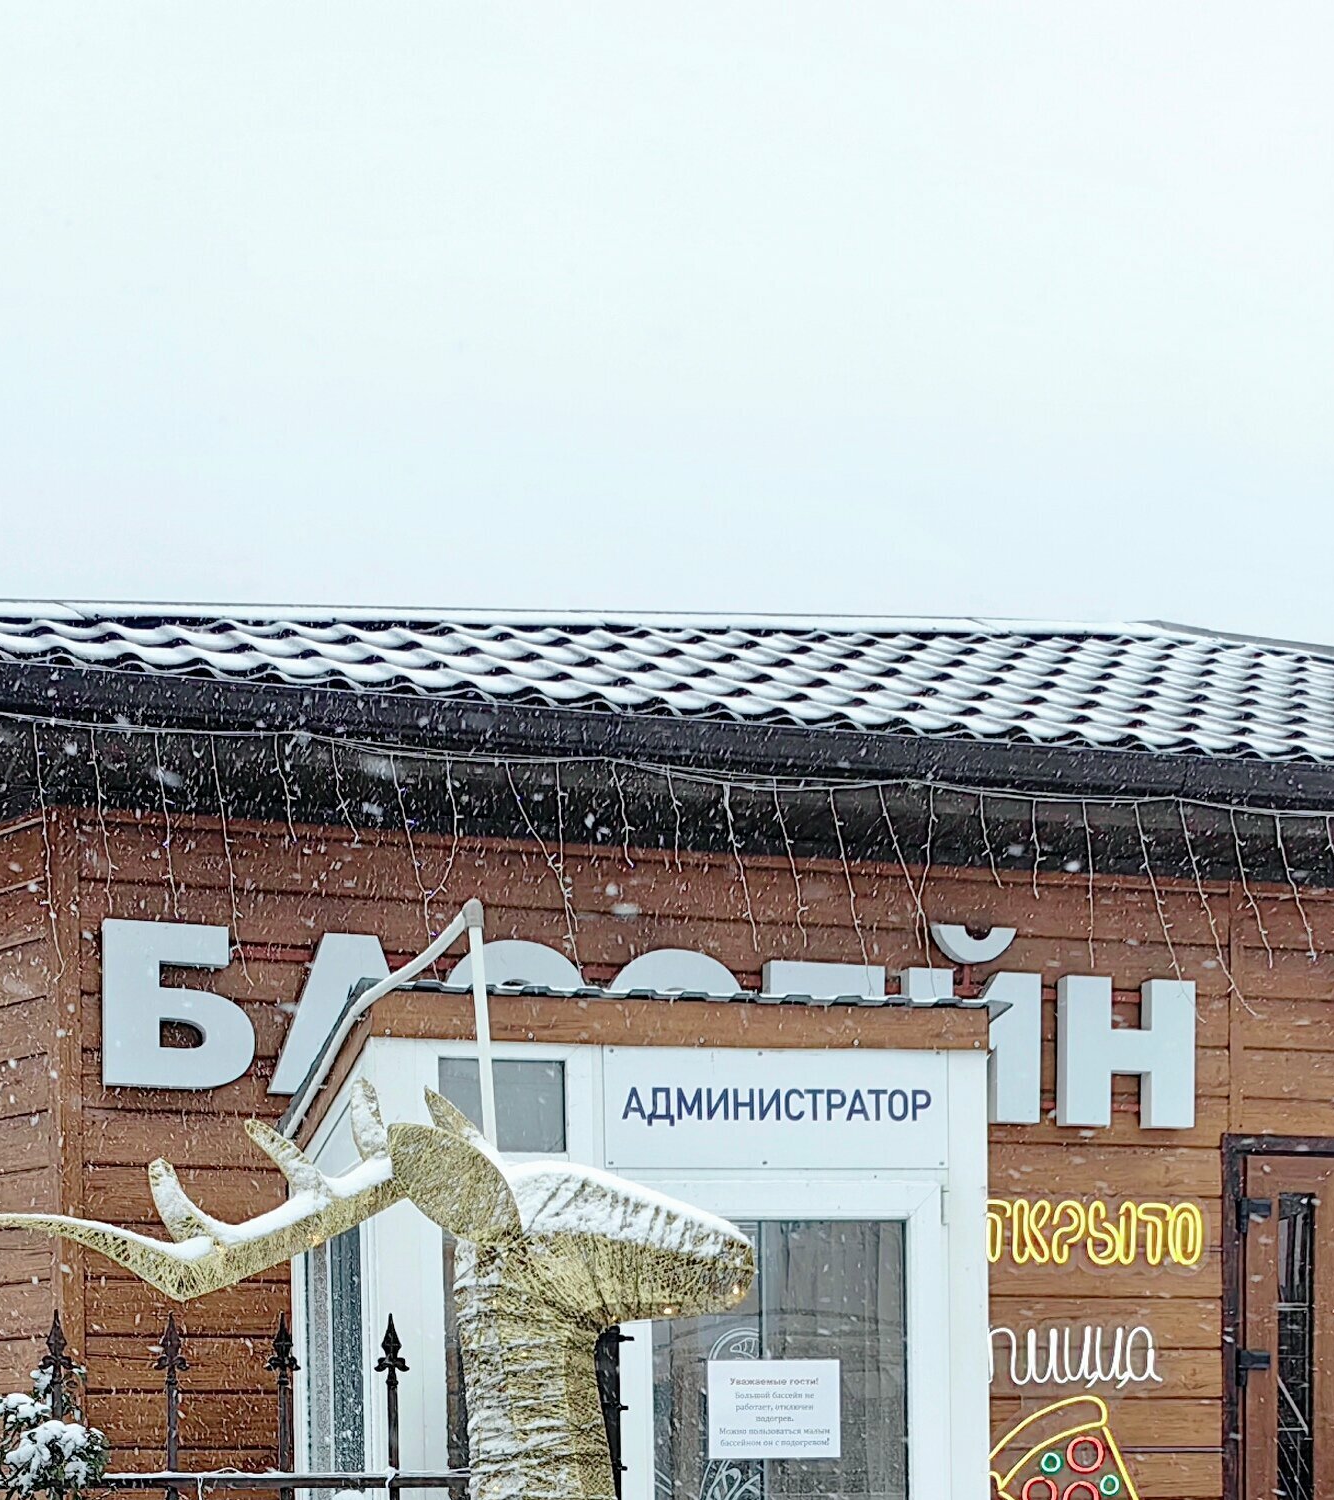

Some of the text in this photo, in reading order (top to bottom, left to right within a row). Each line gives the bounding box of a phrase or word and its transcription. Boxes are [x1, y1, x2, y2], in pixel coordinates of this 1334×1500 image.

[622, 1086, 932, 1127] АДМИНИСТРАТОР
[730, 1377, 820, 1386] Уважаемые гости!
[735, 1391, 771, 1399] Большой
[772, 1391, 803, 1399] бассейн
[735, 1403, 773, 1412] работает,
[719, 1427, 747, 1435] Можно
[720, 1439, 761, 1447] бассейном
